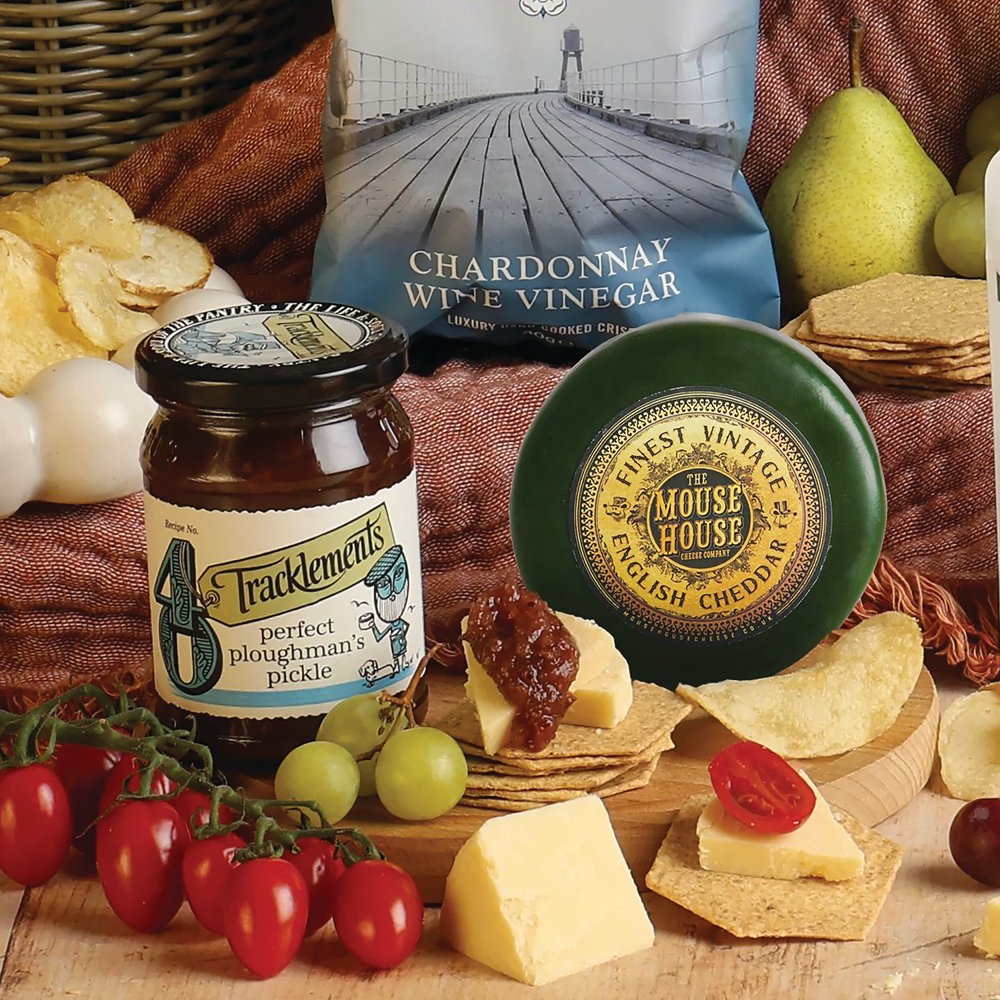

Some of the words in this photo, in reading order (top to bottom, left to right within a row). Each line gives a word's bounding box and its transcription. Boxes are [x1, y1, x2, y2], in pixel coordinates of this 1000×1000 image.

[408, 237, 673, 282] CHARDONNAY
[403, 281, 502, 311] WINE
[516, 271, 681, 311] VINEGAR
[163, 316, 194, 332] THE
[195, 303, 265, 321] PANTRY
[282, 302, 323, 311] THE
[325, 304, 361, 318] LIFE
[447, 314, 496, 332] LUXURY
[615, 426, 686, 488] FINEST
[703, 425, 788, 494] VINTAGE
[686, 472, 708, 486] THE
[654, 484, 743, 521] MOUSE
[164, 519, 185, 533] Recipe
[187, 524, 199, 535] No.
[658, 516, 743, 556] HOUSE
[211, 511, 385, 614] Tracklements
[680, 552, 702, 561] CHEESE
[703, 549, 731, 559] COMPANY
[611, 533, 688, 609] ENGLISH
[699, 538, 788, 610] CHEDDAR
[260, 618, 336, 645] perfect
[229, 635, 366, 669] ploughman's
[266, 662, 333, 689] pickle
